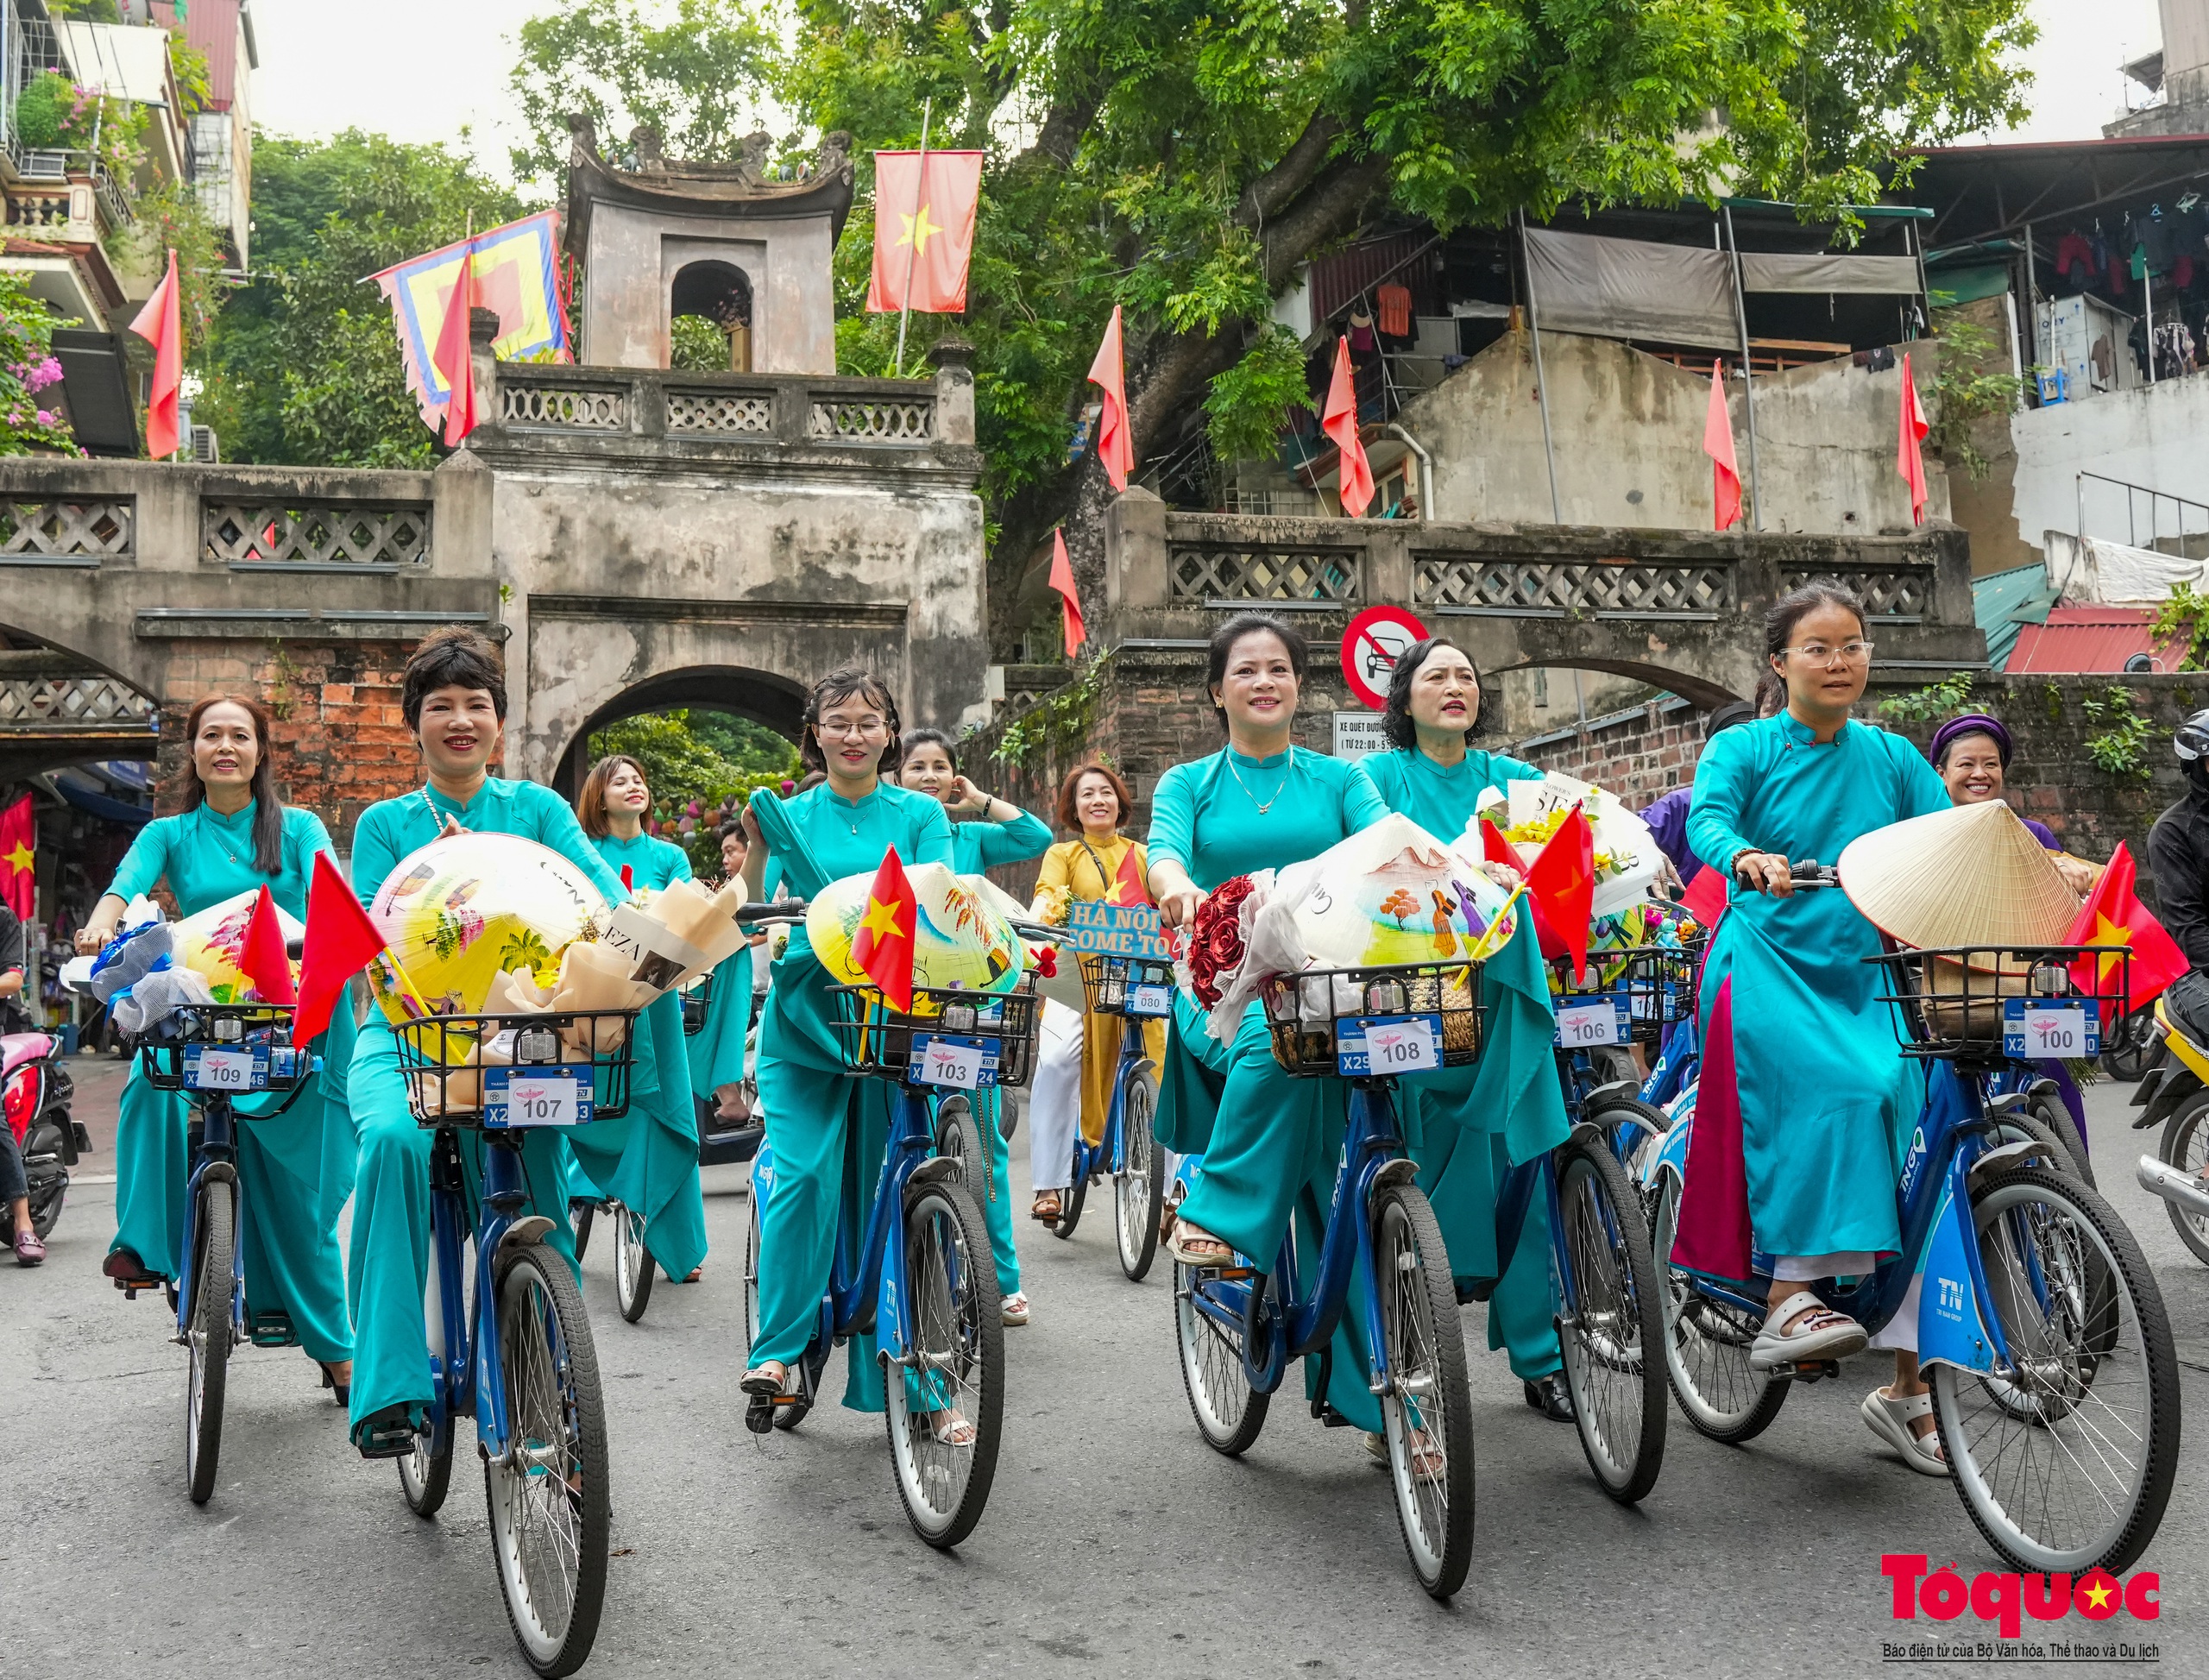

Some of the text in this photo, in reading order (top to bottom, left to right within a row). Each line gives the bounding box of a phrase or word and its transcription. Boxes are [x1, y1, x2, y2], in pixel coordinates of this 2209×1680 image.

[1339, 721, 1348, 732] XE
[1355, 739, 1376, 750] 22:00
[1073, 901, 1161, 935] HÀ NỘI
[601, 925, 642, 962] EZA
[1066, 928, 1171, 956] COME TO
[1140, 997, 1161, 1008] 080
[1572, 1022, 1606, 1041] 106
[2039, 1029, 2074, 1049] 100
[1382, 1041, 1420, 1063] 108
[211, 1067, 242, 1083] 109
[935, 1061, 967, 1082] 103
[978, 1071, 994, 1085] 24
[523, 1098, 563, 1119] 107
[1938, 1277, 1964, 1312] TN
